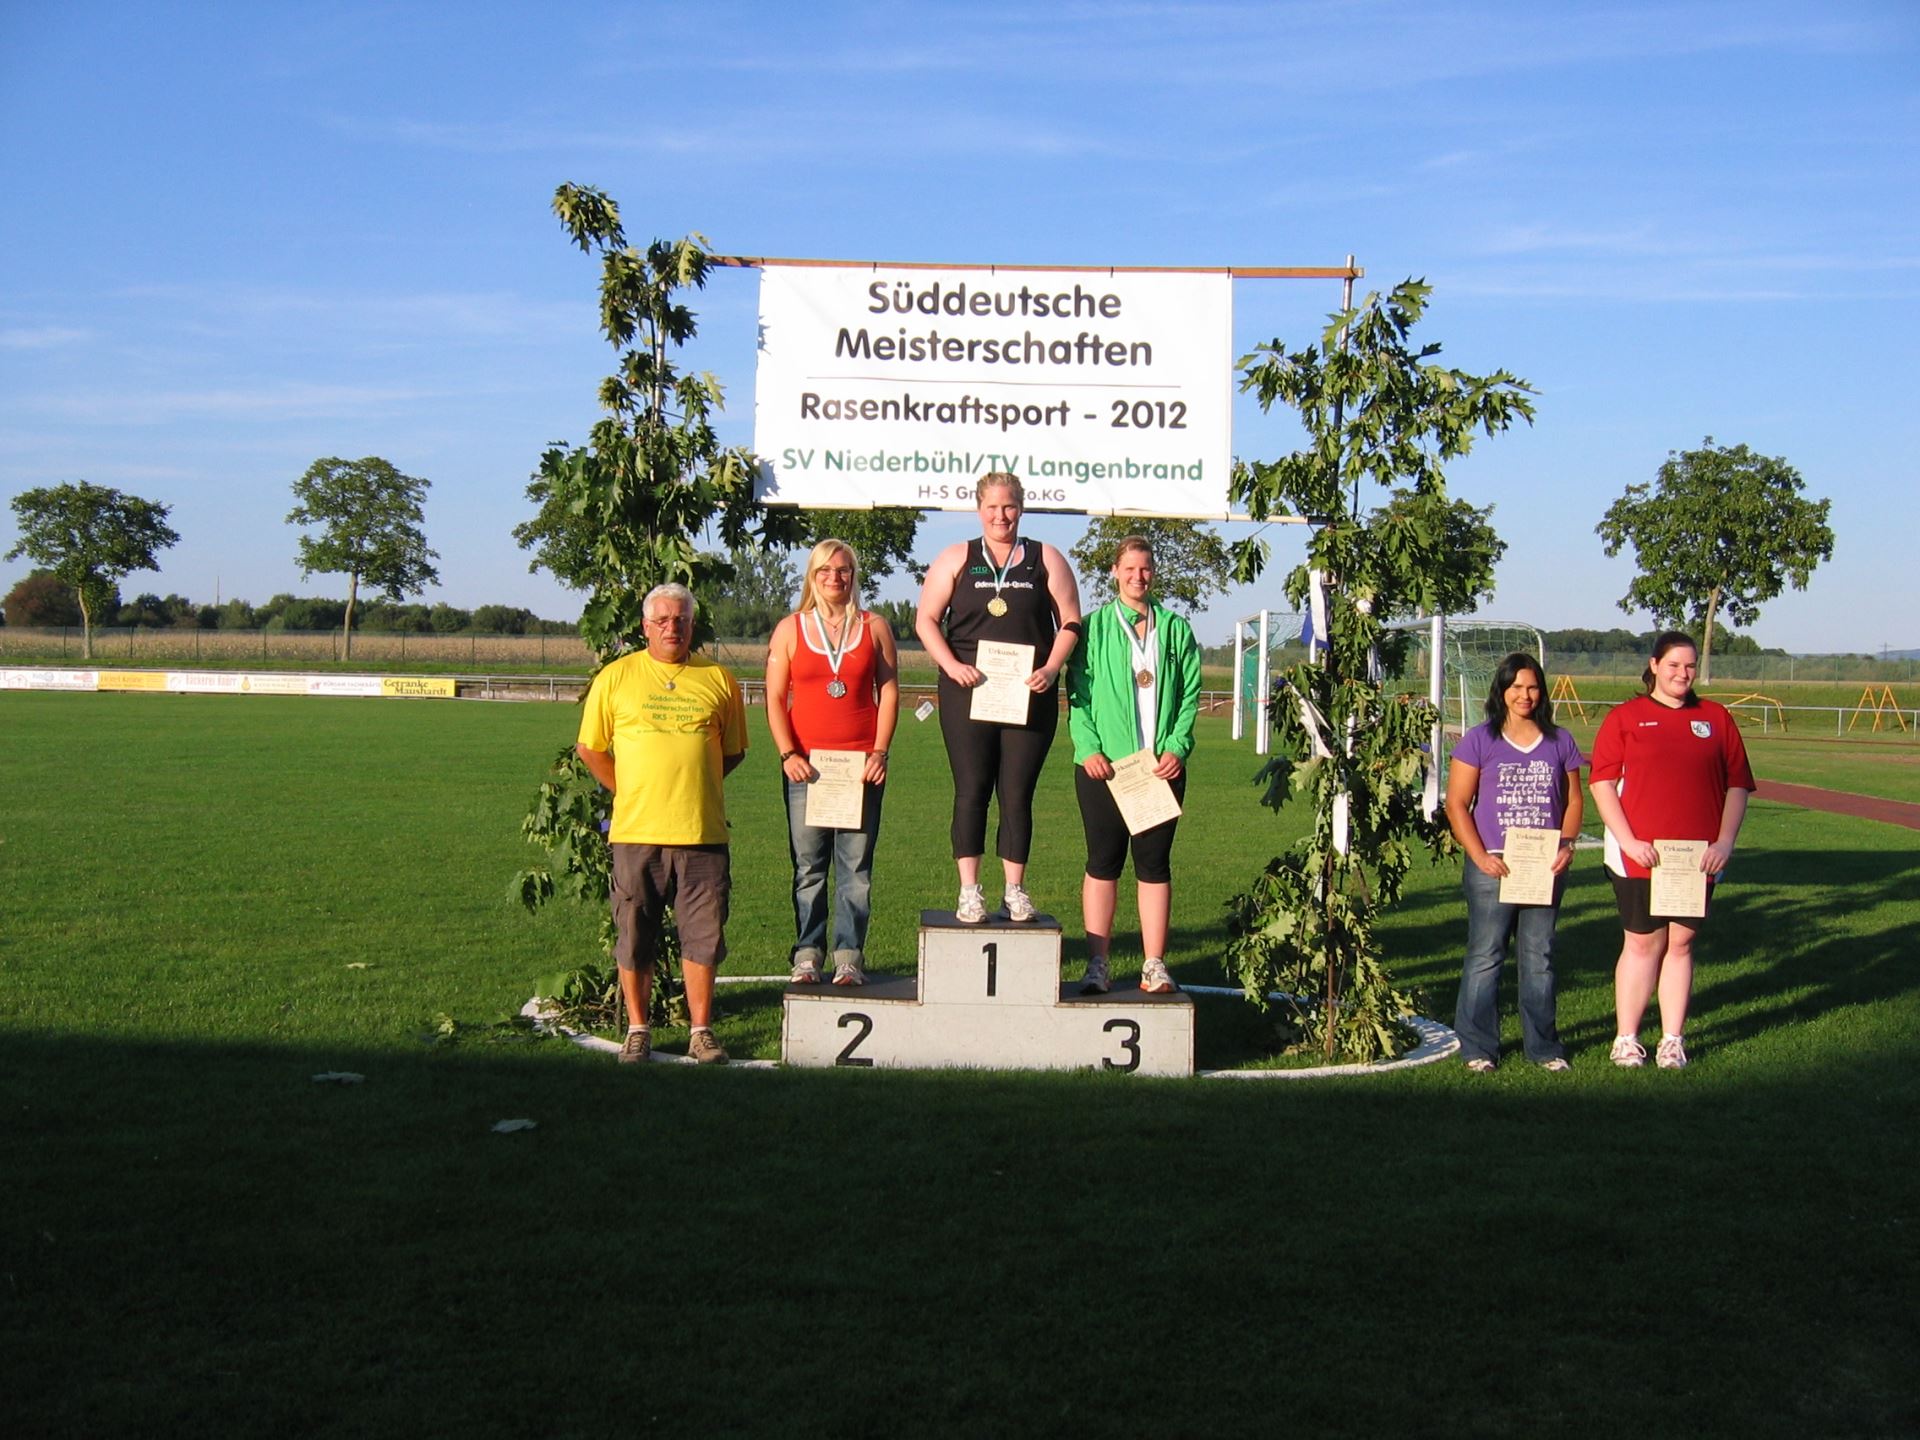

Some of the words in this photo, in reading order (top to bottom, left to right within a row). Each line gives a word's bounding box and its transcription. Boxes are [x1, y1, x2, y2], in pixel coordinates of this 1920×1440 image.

[867, 280, 1122, 319] Süddeutsche
[834, 327, 1153, 367] Meisterschaften
[800, 392, 1071, 433] Rasenkraftsport
[1110, 399, 1188, 430] 2012
[782, 448, 815, 470] SV
[1028, 455, 1204, 484] Langenbrand
[918, 485, 949, 500] H-S
[982, 942, 998, 997] 1
[835, 1012, 874, 1067] 2
[1101, 1018, 1141, 1073] 3
